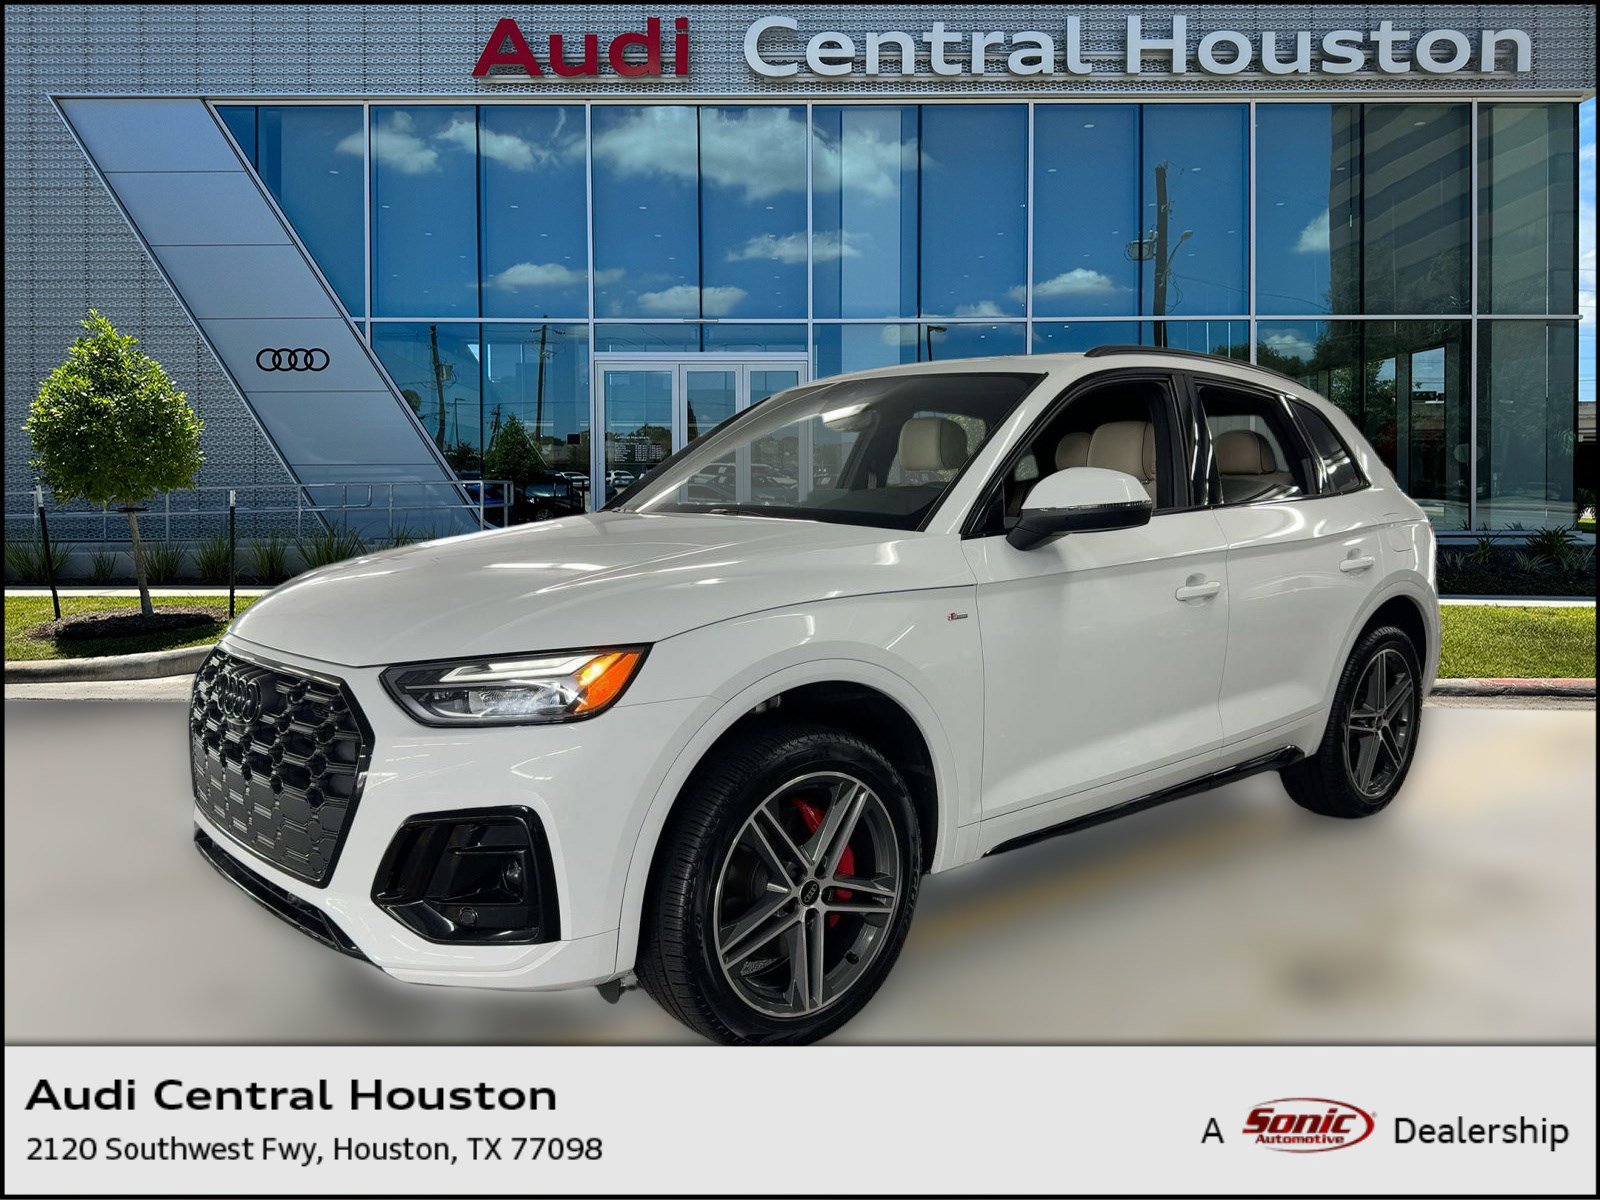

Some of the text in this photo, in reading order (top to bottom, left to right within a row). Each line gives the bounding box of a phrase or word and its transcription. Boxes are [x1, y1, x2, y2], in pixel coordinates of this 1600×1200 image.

[472, 15, 1532, 77] Audi Central Houston
